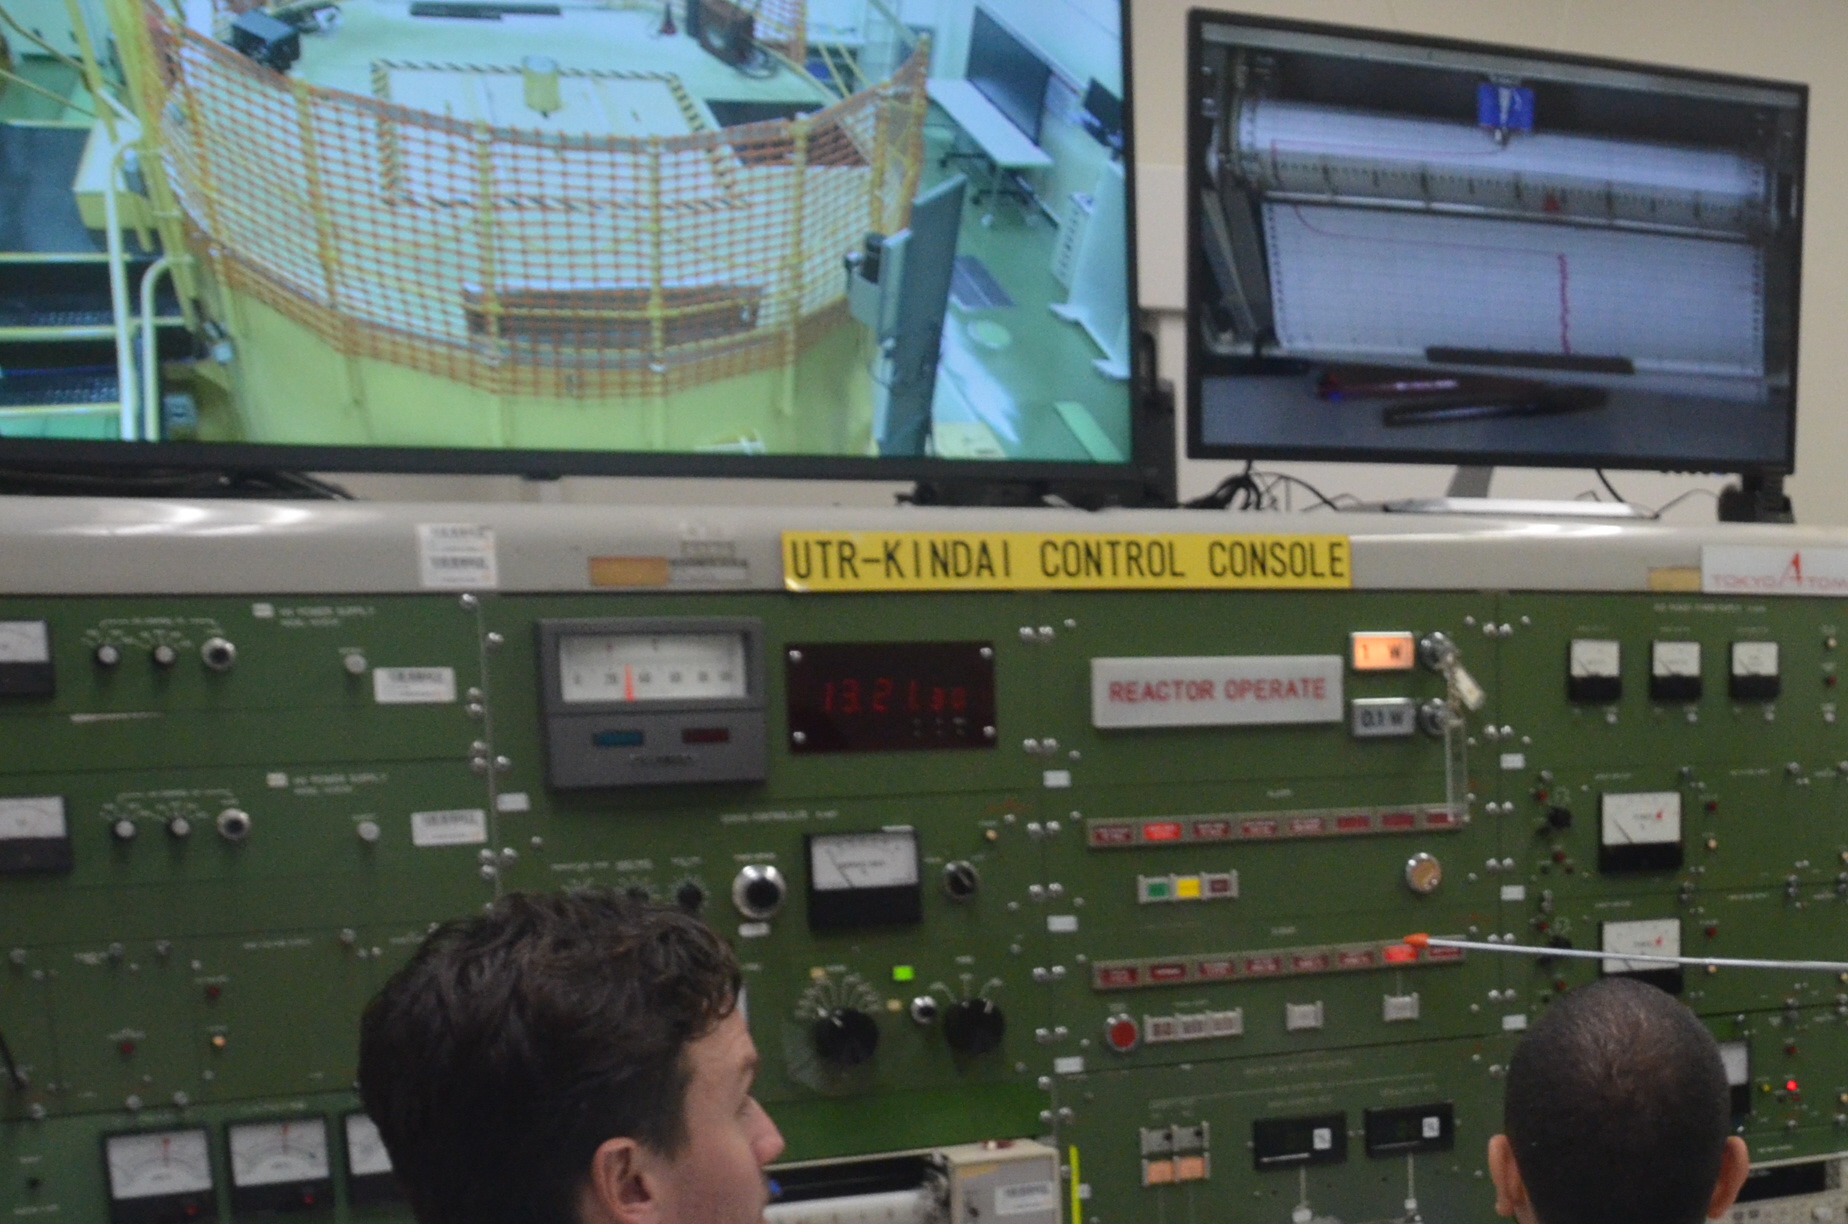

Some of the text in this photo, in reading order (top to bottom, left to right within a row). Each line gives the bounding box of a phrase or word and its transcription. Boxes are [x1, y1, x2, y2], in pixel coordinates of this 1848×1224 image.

[790, 539, 1011, 579] UTR-KINDAI
[1039, 539, 1186, 578] CONTROL
[1207, 540, 1345, 578] CONSOLE
[1109, 676, 1327, 703] REACTOR OPERATE
